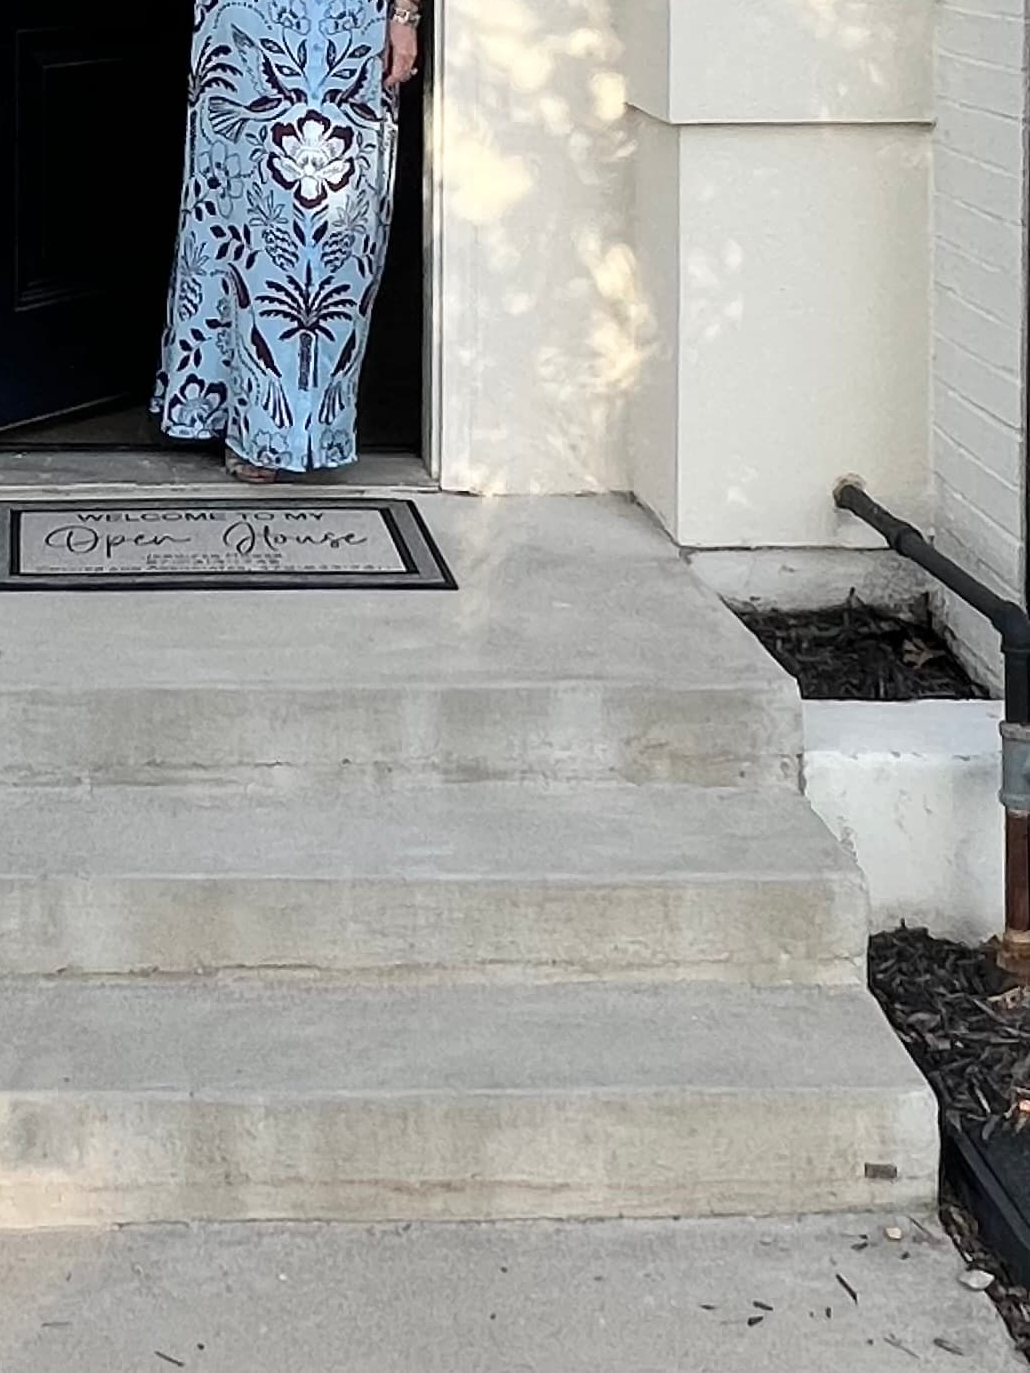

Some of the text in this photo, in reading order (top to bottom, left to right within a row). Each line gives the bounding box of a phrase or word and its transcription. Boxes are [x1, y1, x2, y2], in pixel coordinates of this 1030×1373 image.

[77, 512, 324, 522] WELCOME TO MY
[44, 521, 369, 559] Open House
